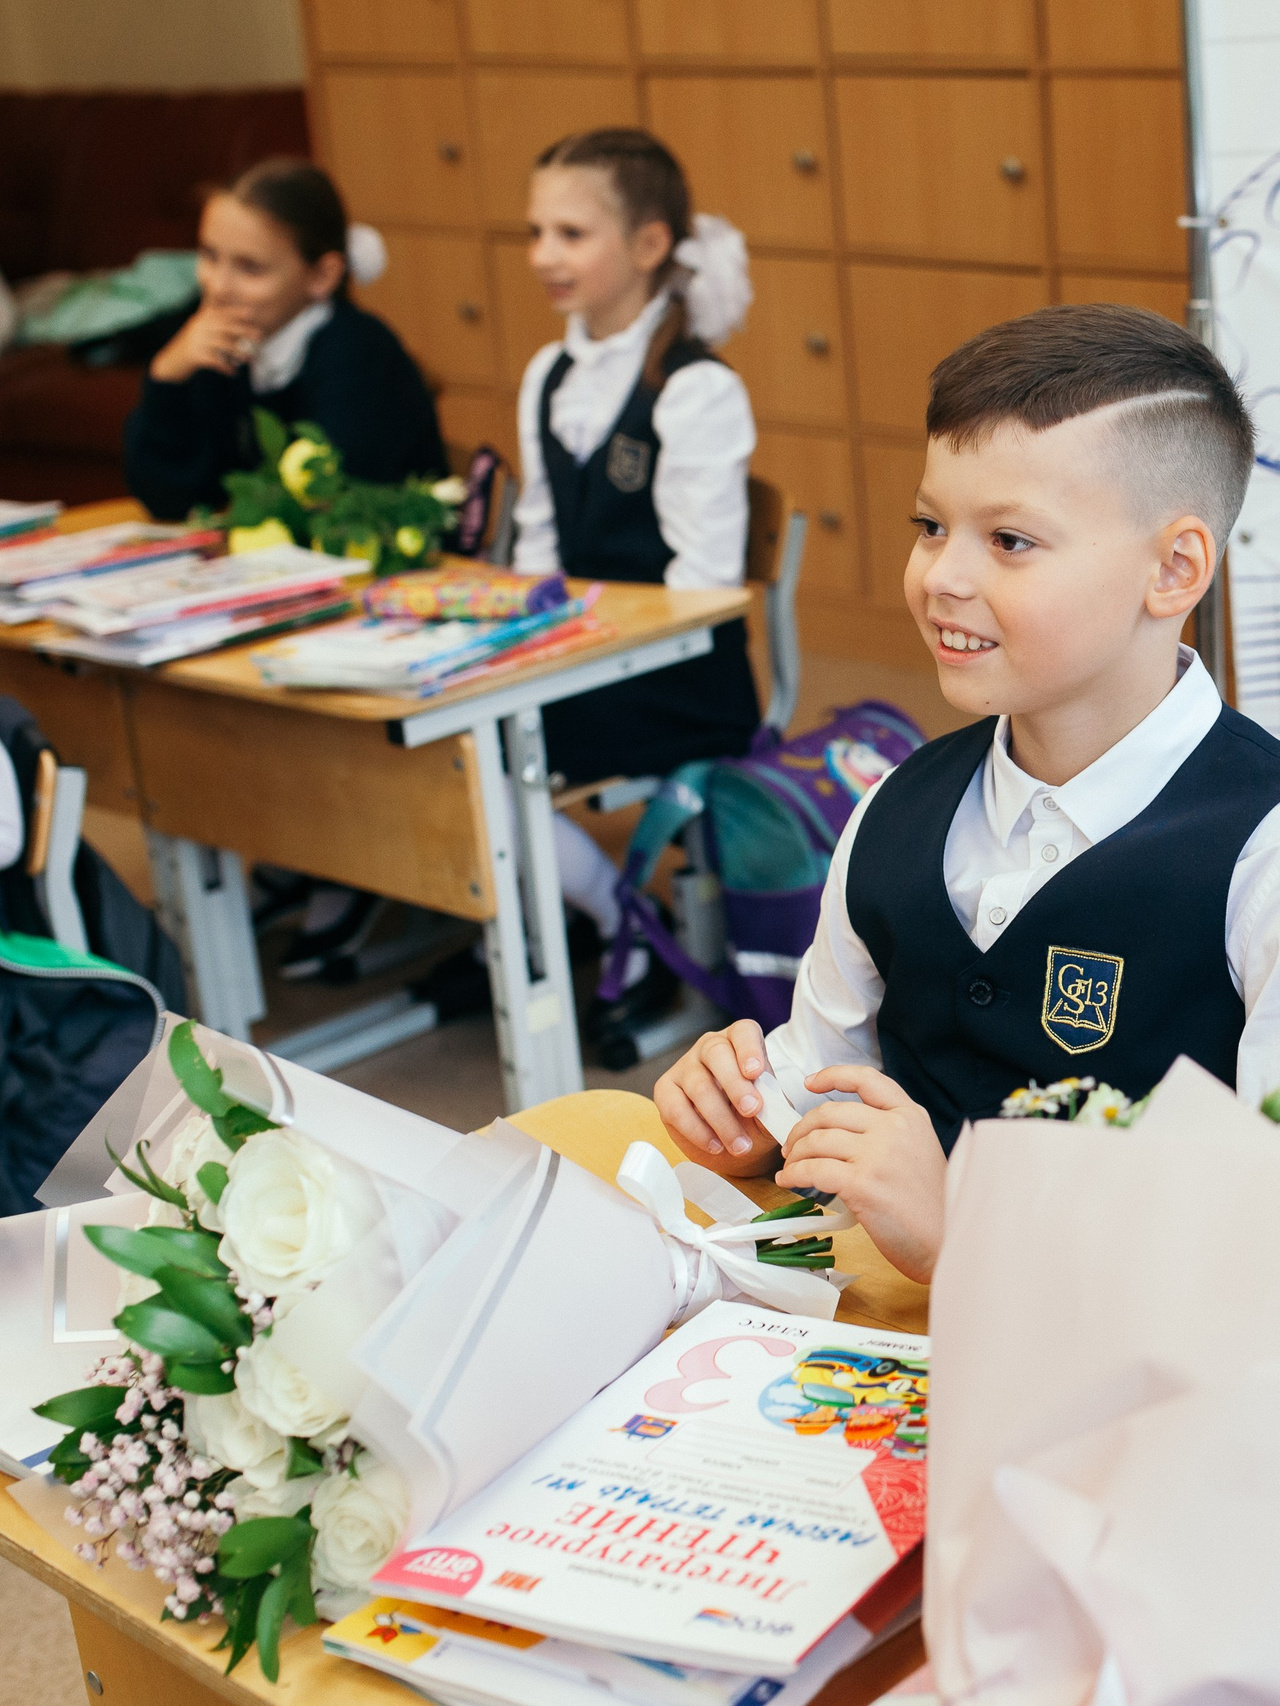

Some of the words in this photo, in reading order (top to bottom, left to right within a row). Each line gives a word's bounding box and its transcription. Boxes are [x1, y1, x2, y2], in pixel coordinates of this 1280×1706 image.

[738, 1318, 809, 1337] класс
[644, 1335, 797, 1414] 3
[599, 1485, 727, 1521] ТЕТРАДЬ
[554, 1501, 780, 1565] ЧТЕНИЕ
[736, 1513, 878, 1547] РАБОЧАЯ
[485, 1522, 808, 1604] Литературное
